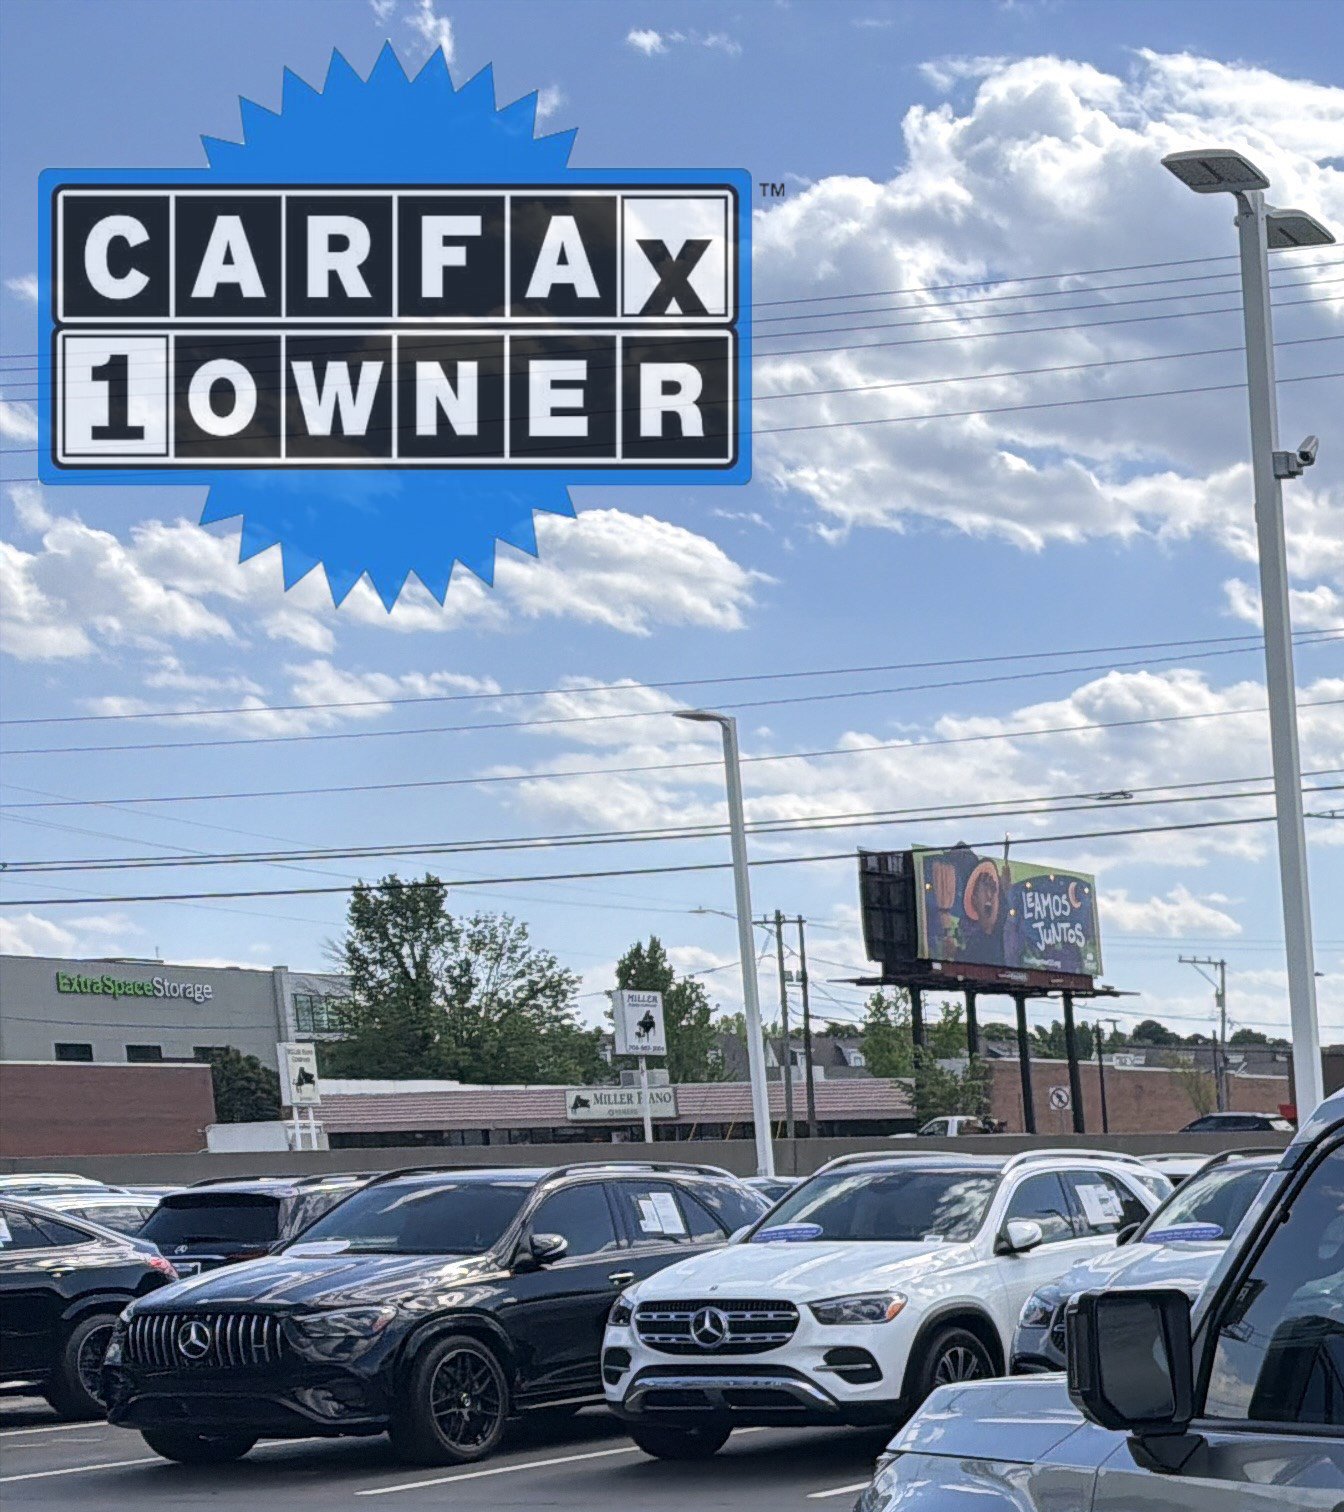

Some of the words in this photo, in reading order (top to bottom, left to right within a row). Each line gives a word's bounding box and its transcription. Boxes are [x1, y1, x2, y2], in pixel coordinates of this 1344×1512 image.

[1021, 891, 1071, 920] LEAMOS
[1032, 920, 1086, 951] JUNTOS
[627, 994, 658, 1003] MILLER
[593, 1092, 634, 1105] MILLER
[636, 1091, 672, 1104] PANO
